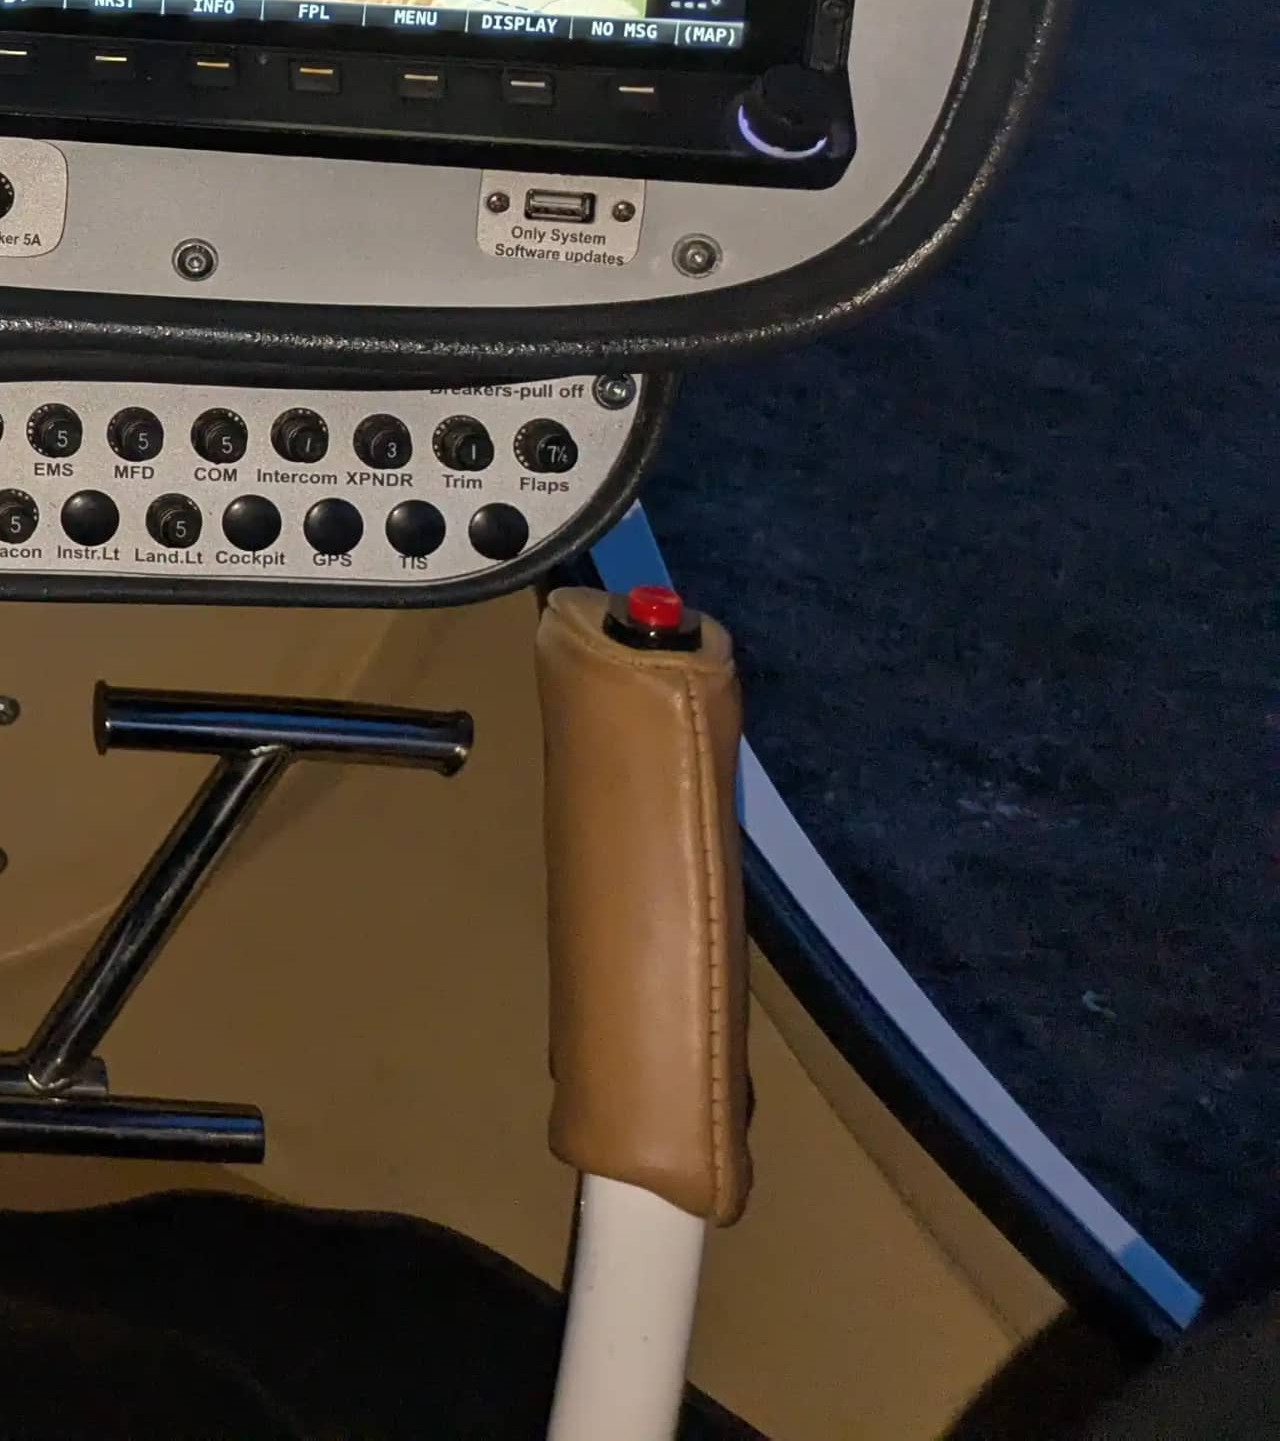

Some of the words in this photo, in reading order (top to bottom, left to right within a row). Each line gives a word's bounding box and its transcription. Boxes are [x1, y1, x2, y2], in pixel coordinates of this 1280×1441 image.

[23, 233, 41, 247] 5A
[34, 463, 74, 478] EMS
[114, 465, 155, 480] MFD
[194, 467, 238, 482] COM
[256, 469, 338, 486] Intercom
[346, 472, 413, 488] XPNDR
[442, 475, 483, 490] Trim
[520, 477, 570, 494] Flaps
[57, 545, 120, 561] Instr.Lt
[135, 549, 203, 565] Land.Lt
[210, 551, 285, 566] Cockpit
[313, 553, 352, 567] GPS
[400, 556, 428, 569] TIS
